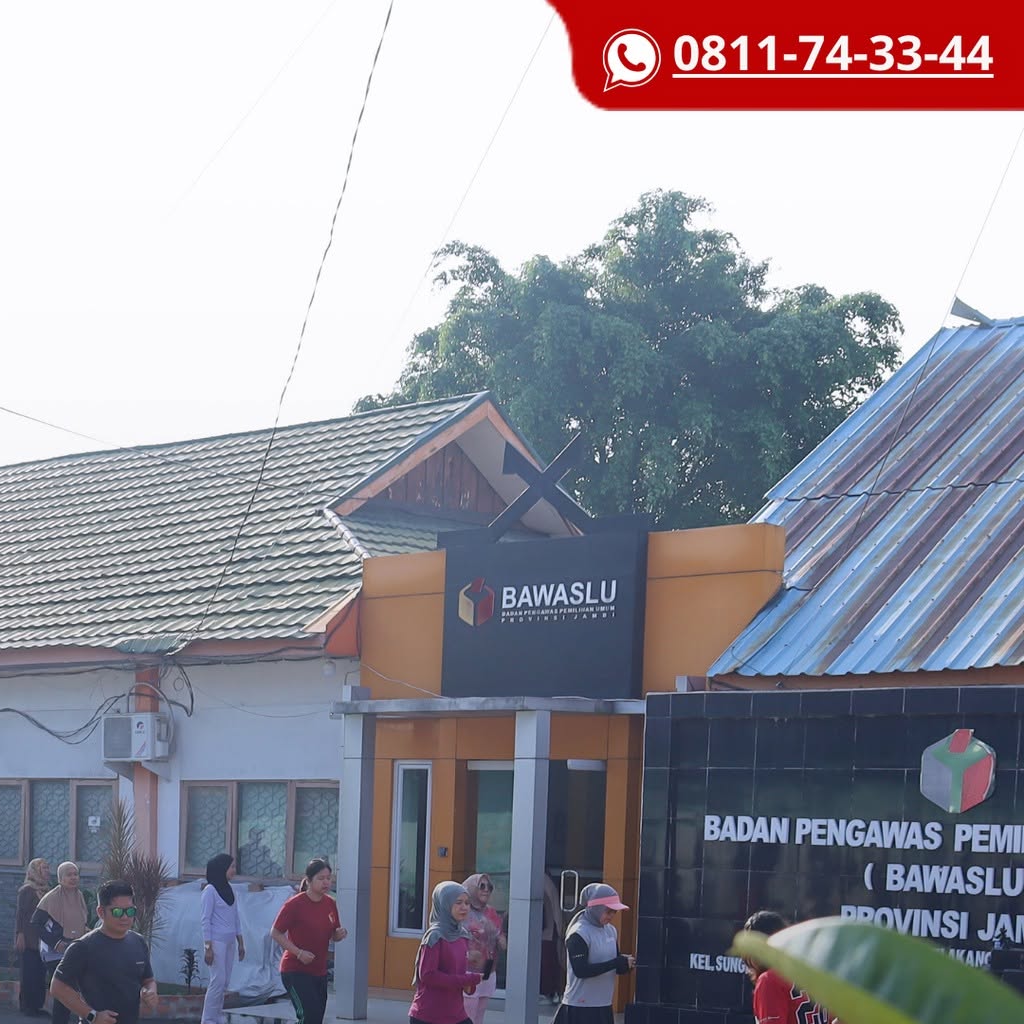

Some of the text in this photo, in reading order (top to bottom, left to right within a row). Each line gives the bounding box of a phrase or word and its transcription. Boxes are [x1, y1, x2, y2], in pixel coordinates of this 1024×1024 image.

[502, 580, 616, 609] BAWASLU
[704, 815, 1024, 854] BADAN PENGAWAS PEMI
[886, 863, 1024, 897] BAWASLU
[840, 904, 969, 940] PROVINSI
